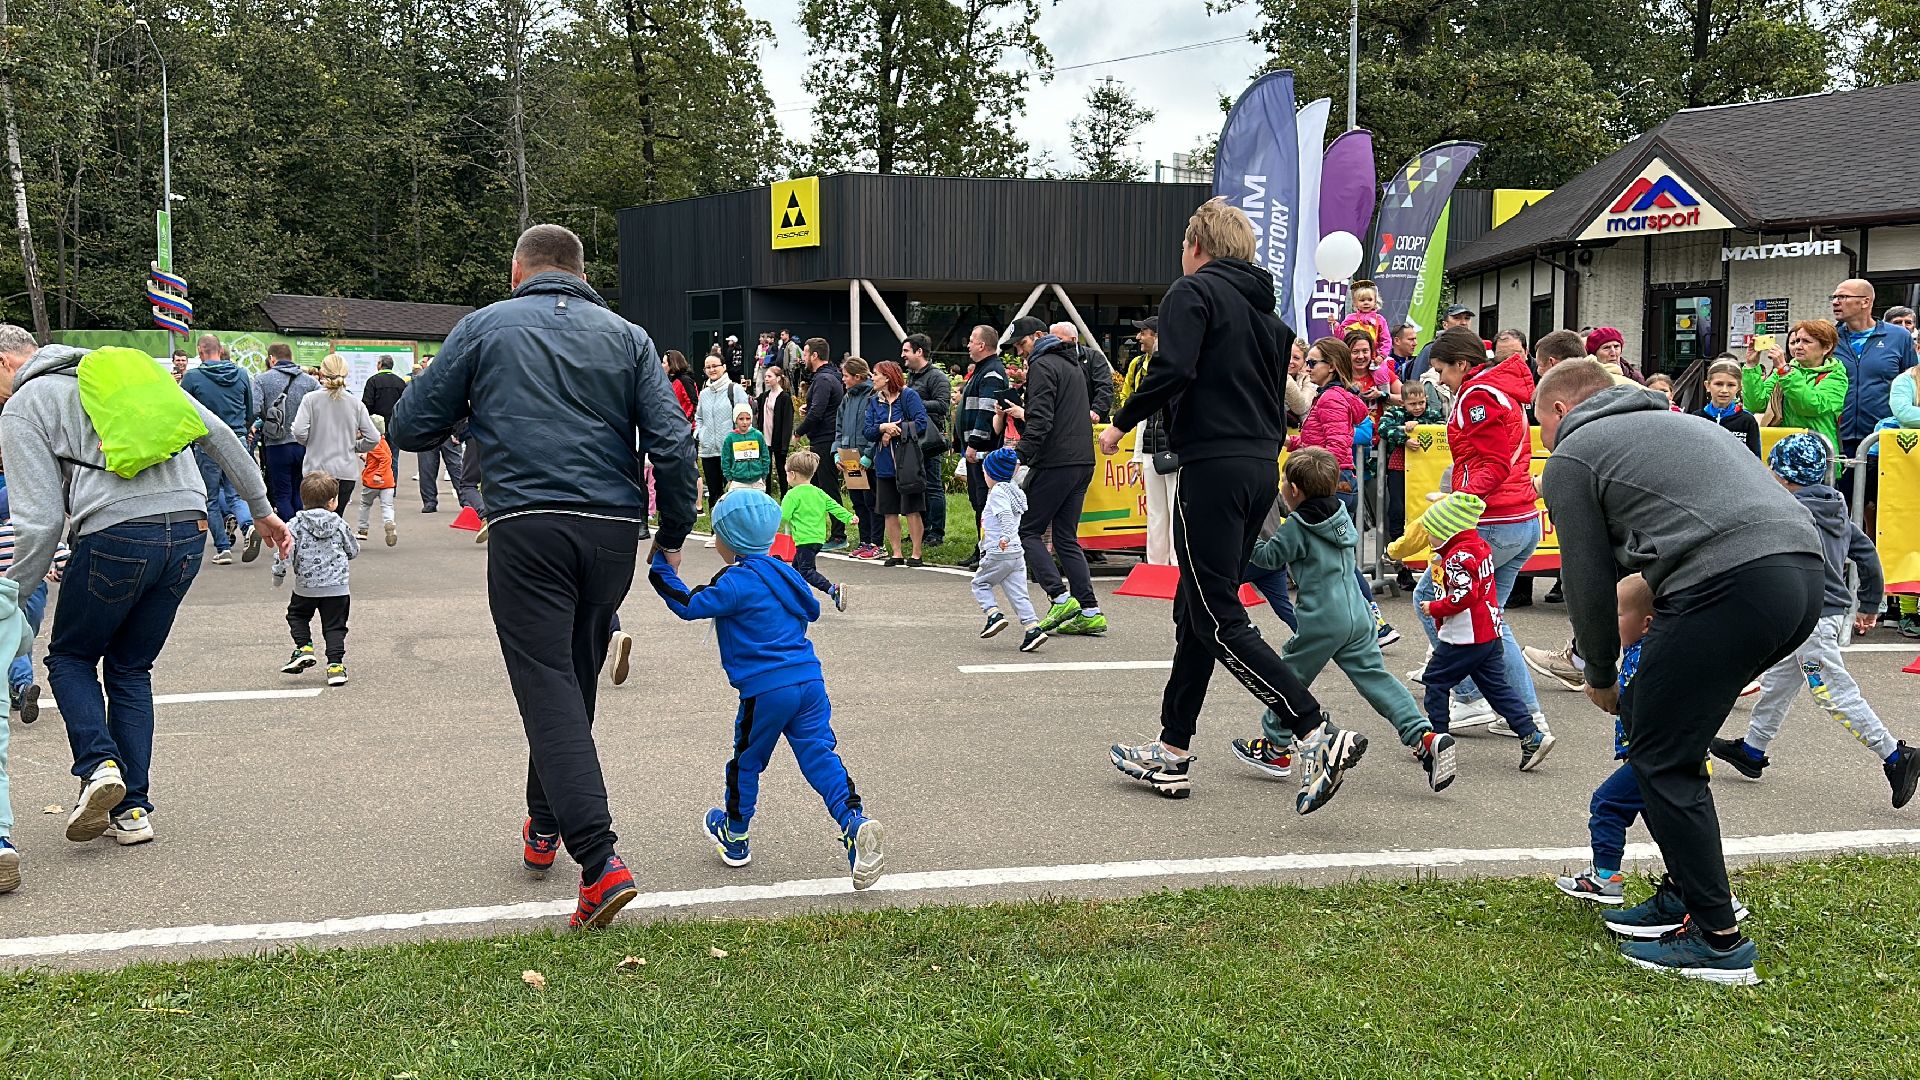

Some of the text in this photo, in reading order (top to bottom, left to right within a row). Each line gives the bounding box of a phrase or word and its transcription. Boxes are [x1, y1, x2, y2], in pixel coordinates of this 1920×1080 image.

[1607, 207, 1700, 232] marsport
[776, 230, 810, 240] FISCHER
[1396, 235, 1426, 251] СПОРТ
[1721, 240, 1841, 261] МАГАЗИН
[1392, 255, 1422, 271] ВЕКТО
